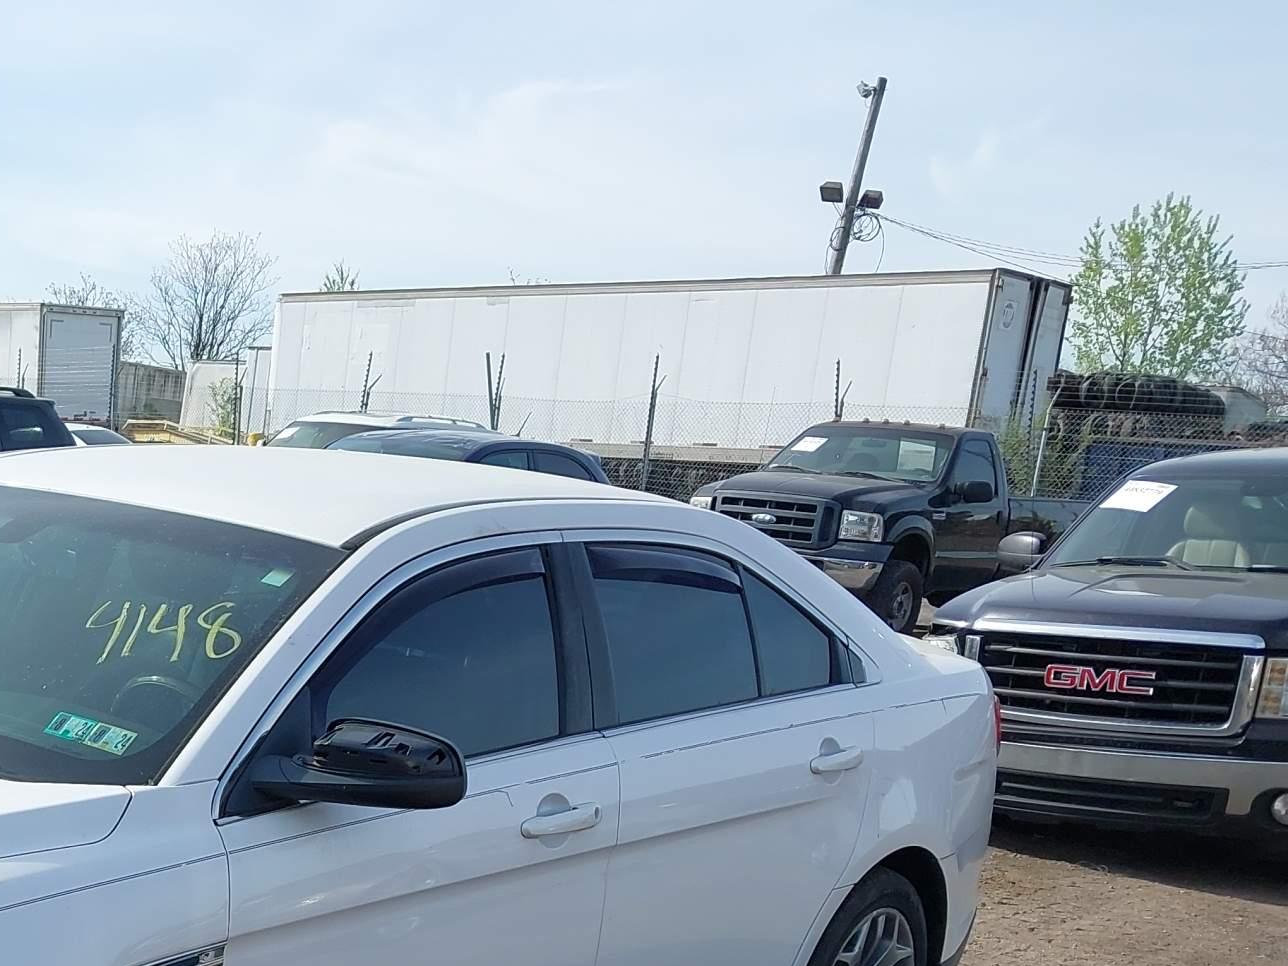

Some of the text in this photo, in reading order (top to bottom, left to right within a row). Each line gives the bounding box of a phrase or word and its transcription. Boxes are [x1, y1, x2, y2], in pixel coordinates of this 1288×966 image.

[1043, 664, 1156, 695] GMC
[74, 720, 94, 738] 24
[113, 732, 134, 751] 24
